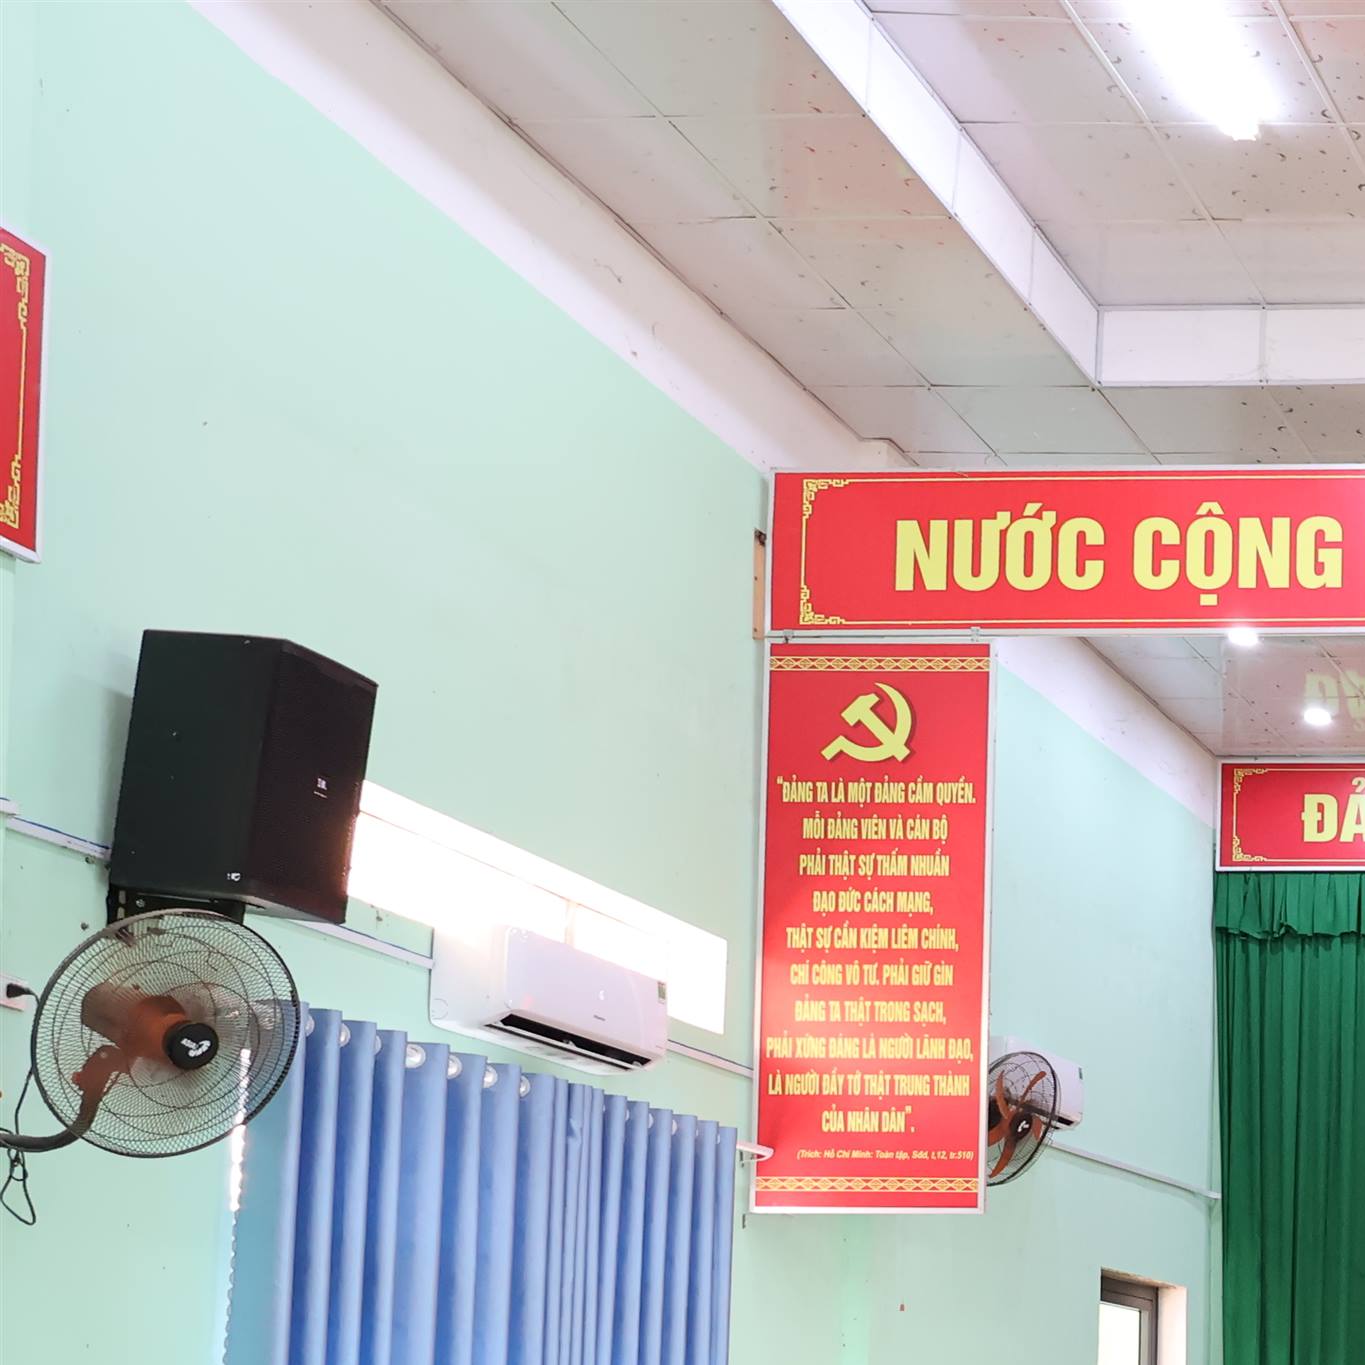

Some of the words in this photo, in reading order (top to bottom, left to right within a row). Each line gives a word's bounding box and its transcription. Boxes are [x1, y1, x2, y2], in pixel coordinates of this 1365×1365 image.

[895, 502, 1105, 592] NƯỚC
[1133, 501, 1343, 608] CỘNG
[820, 1104, 846, 1133] CỦA
[847, 1106, 880, 1133] NHÂN
[881, 1105, 916, 1133] DÂN”.
